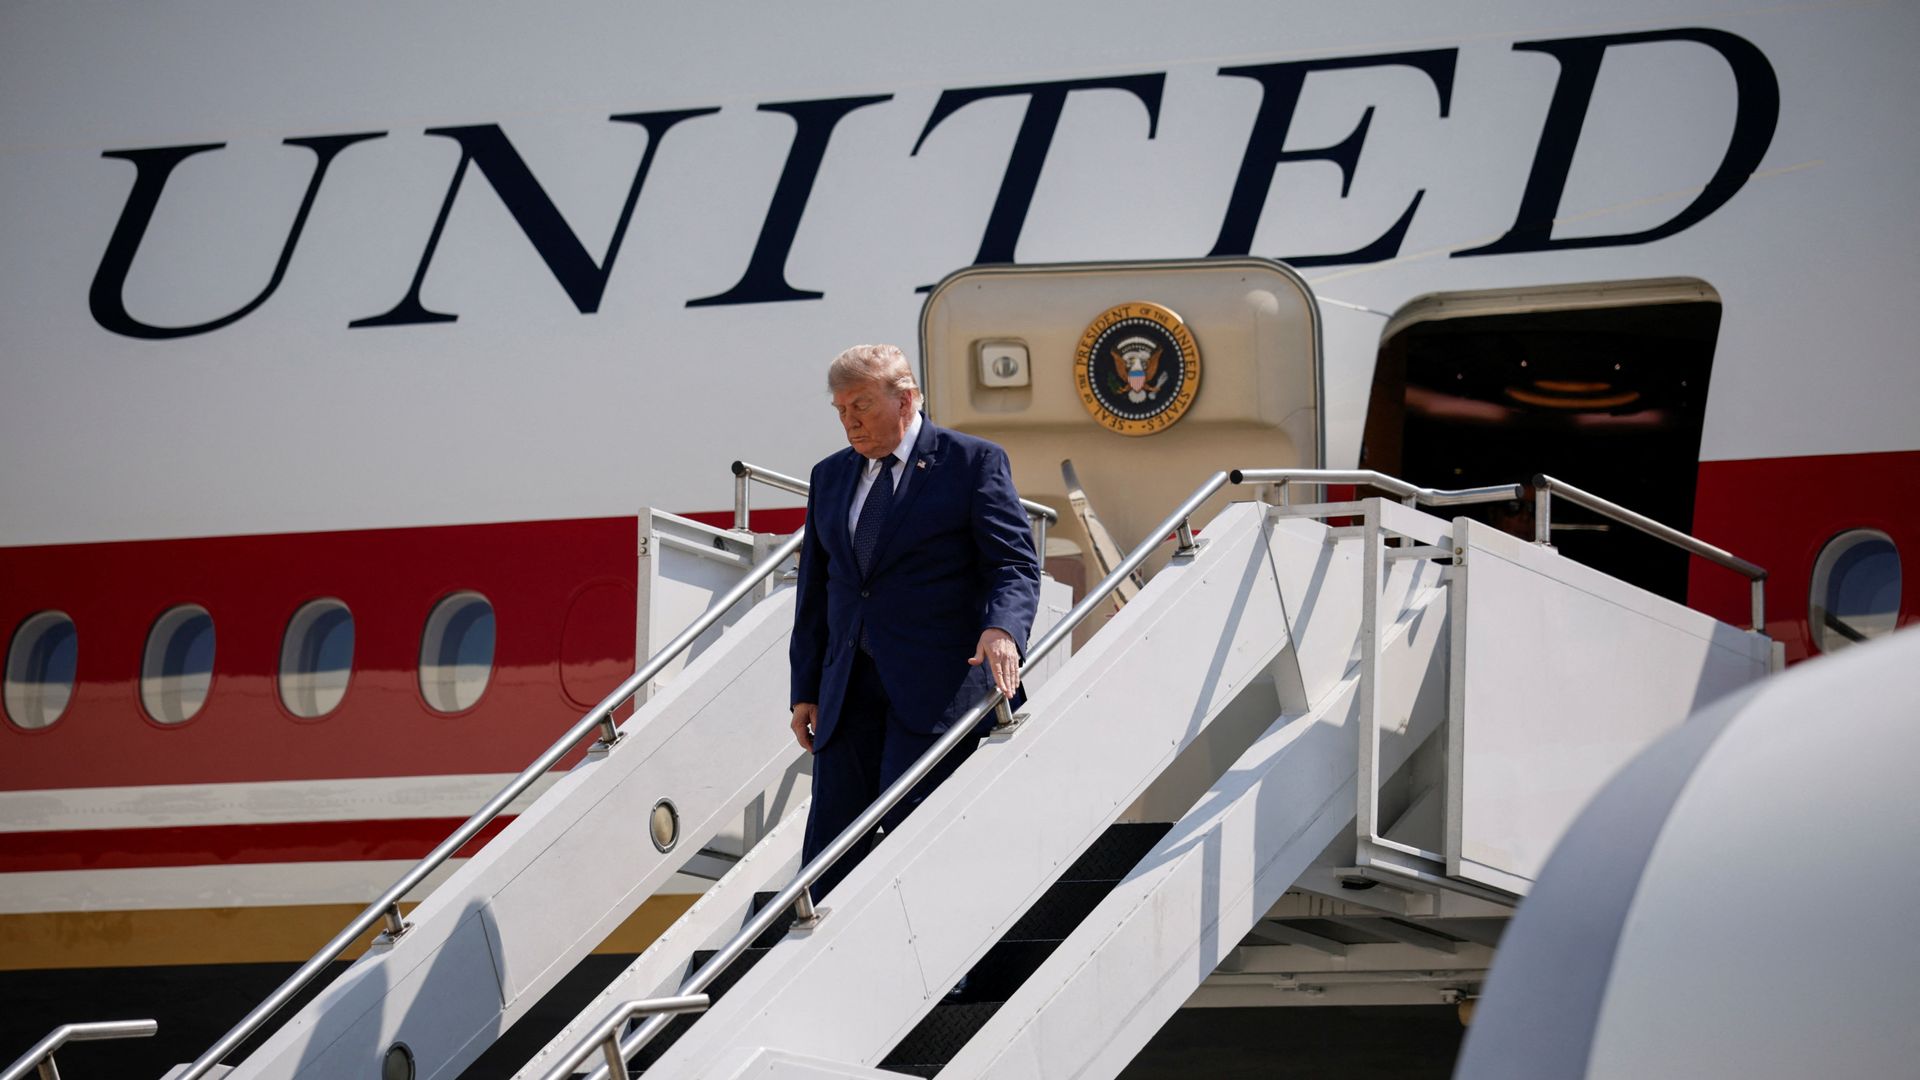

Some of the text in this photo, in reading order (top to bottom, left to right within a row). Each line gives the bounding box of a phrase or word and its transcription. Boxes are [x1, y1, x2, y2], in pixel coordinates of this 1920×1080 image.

[88, 27, 1780, 340] UNITED
[1076, 307, 1196, 431] SEAL OF THE PRESIDENT OF THE UNITED STATES
